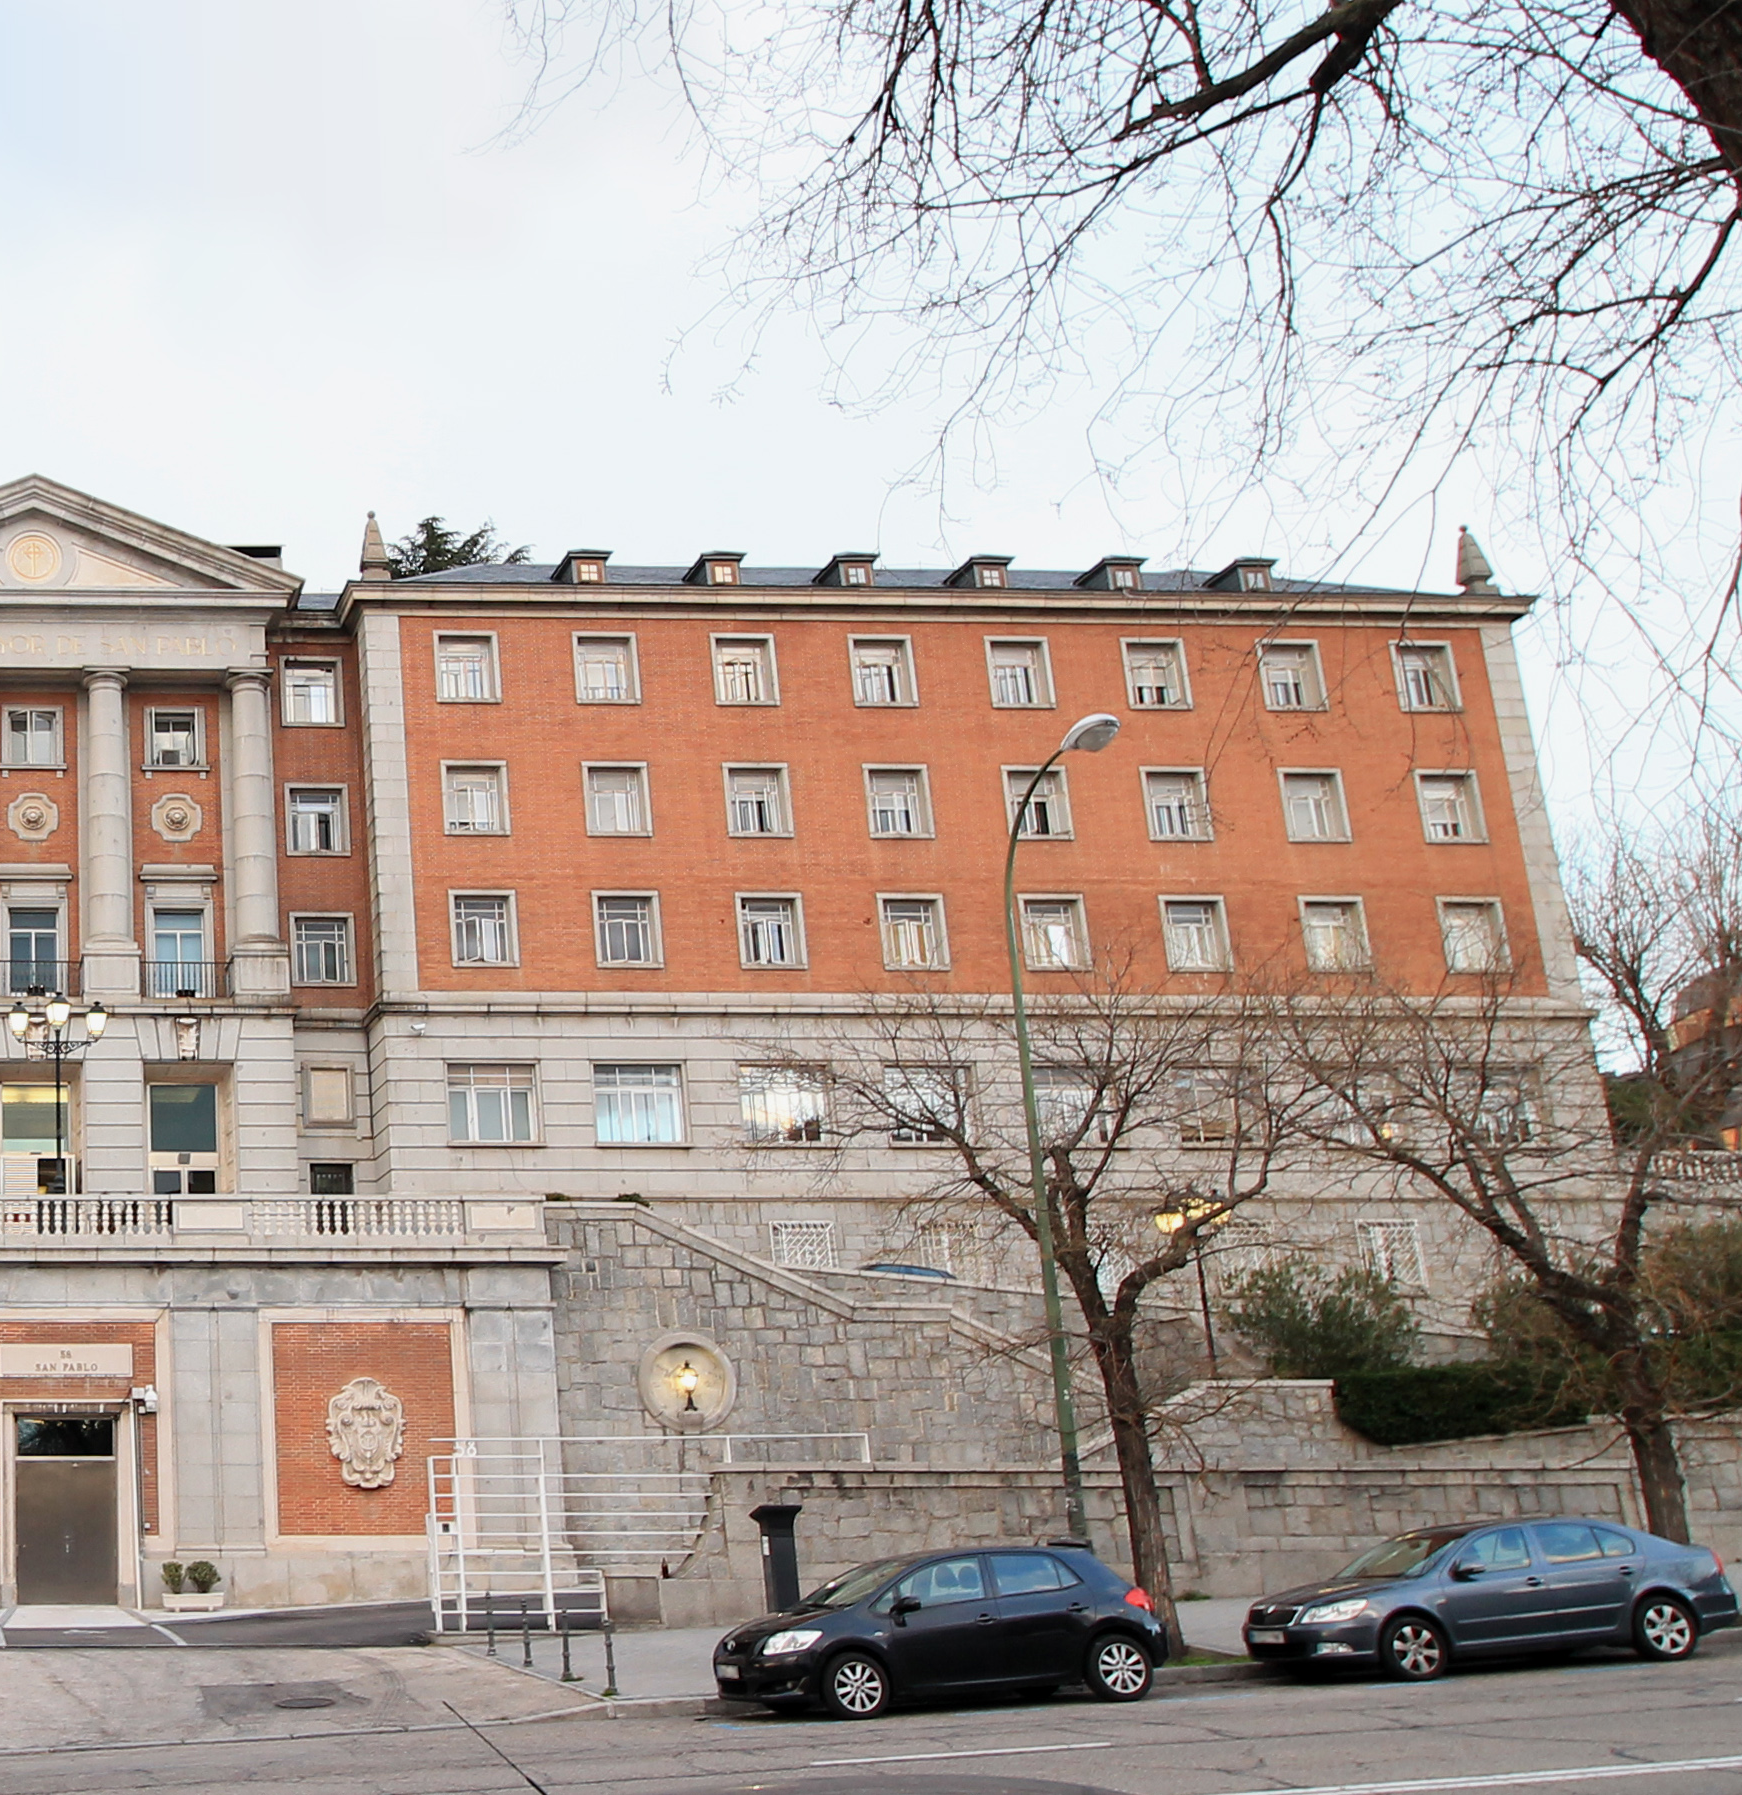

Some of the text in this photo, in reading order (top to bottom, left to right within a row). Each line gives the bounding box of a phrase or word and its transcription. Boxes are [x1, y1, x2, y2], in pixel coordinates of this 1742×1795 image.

[58, 634, 86, 656] DE
[100, 634, 147, 656] SAN
[157, 635, 237, 657] PABLO
[35, 1363, 98, 1372] SAN PABLO
[453, 1441, 477, 1457] 58
